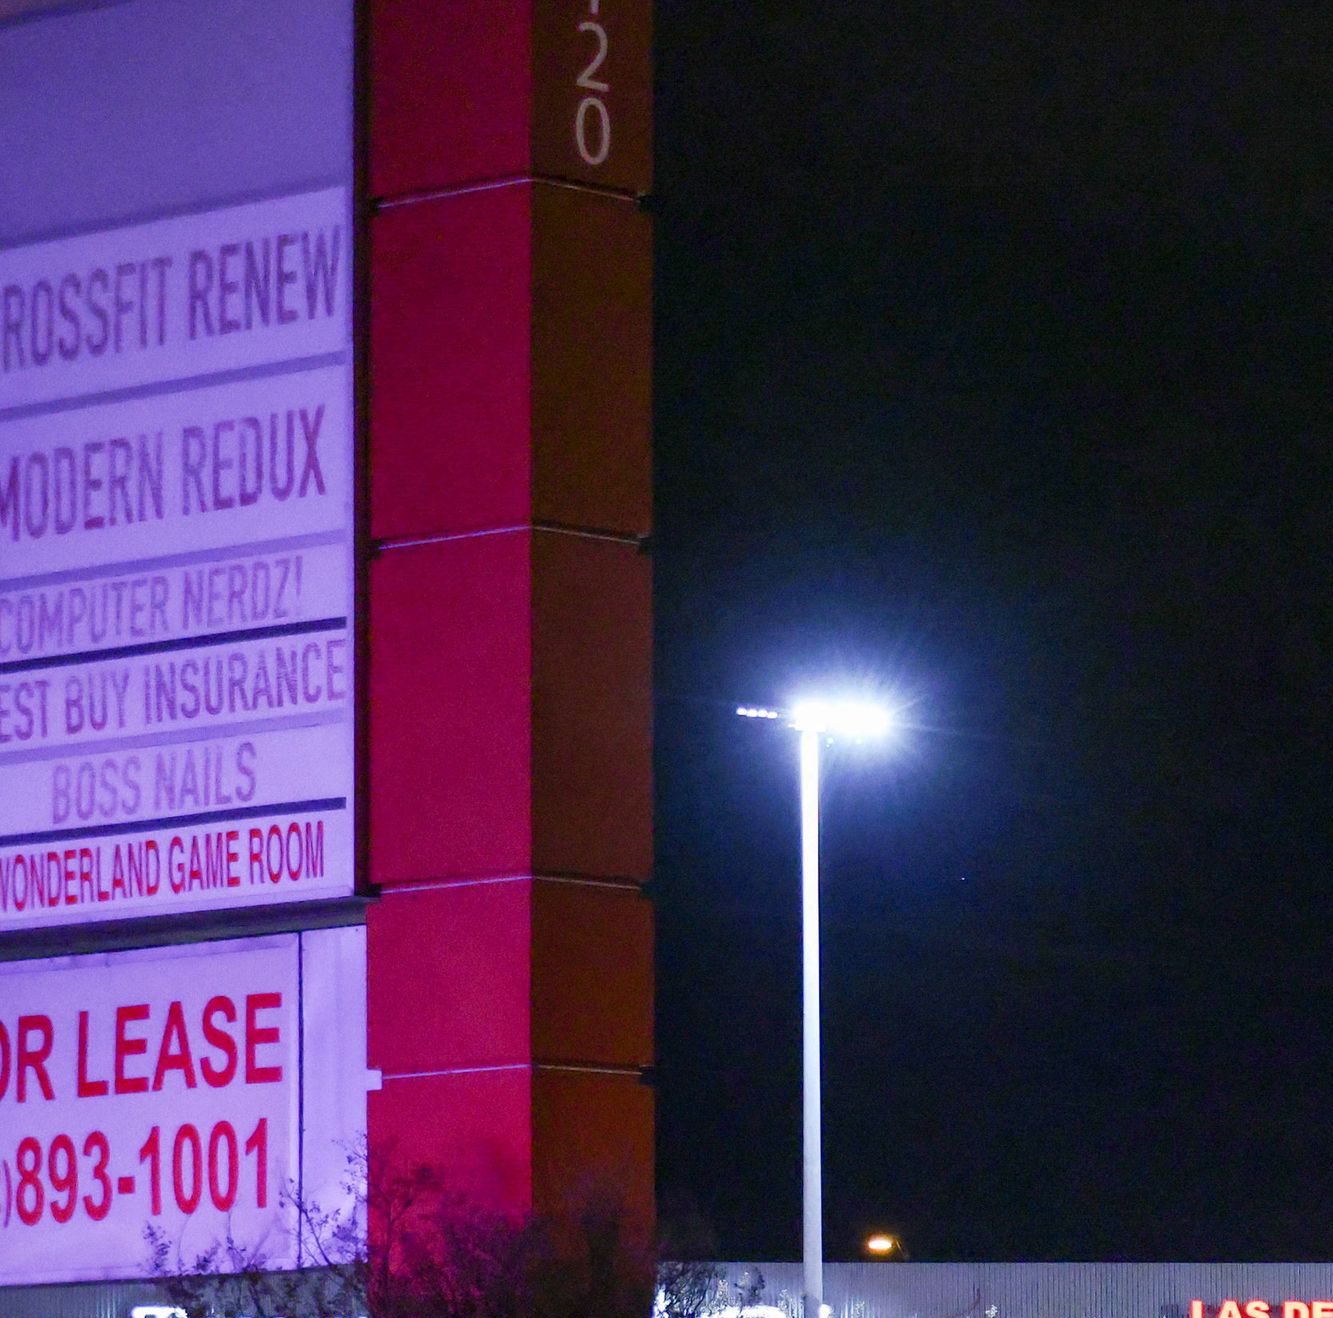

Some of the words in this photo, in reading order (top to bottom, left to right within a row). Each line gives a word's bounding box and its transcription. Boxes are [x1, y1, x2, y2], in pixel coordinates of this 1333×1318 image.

[576, 0, 611, 165] 20
[188, 225, 341, 341] RENEW
[182, 404, 327, 516] REDUX
[65, 671, 130, 735] BUY
[144, 638, 347, 725] INSURANCE
[52, 756, 142, 825] BOSS
[155, 741, 257, 811] NAILS
[168, 830, 241, 894] GAME
[249, 820, 324, 885] ROOM
[77, 992, 283, 1098] LEASE
